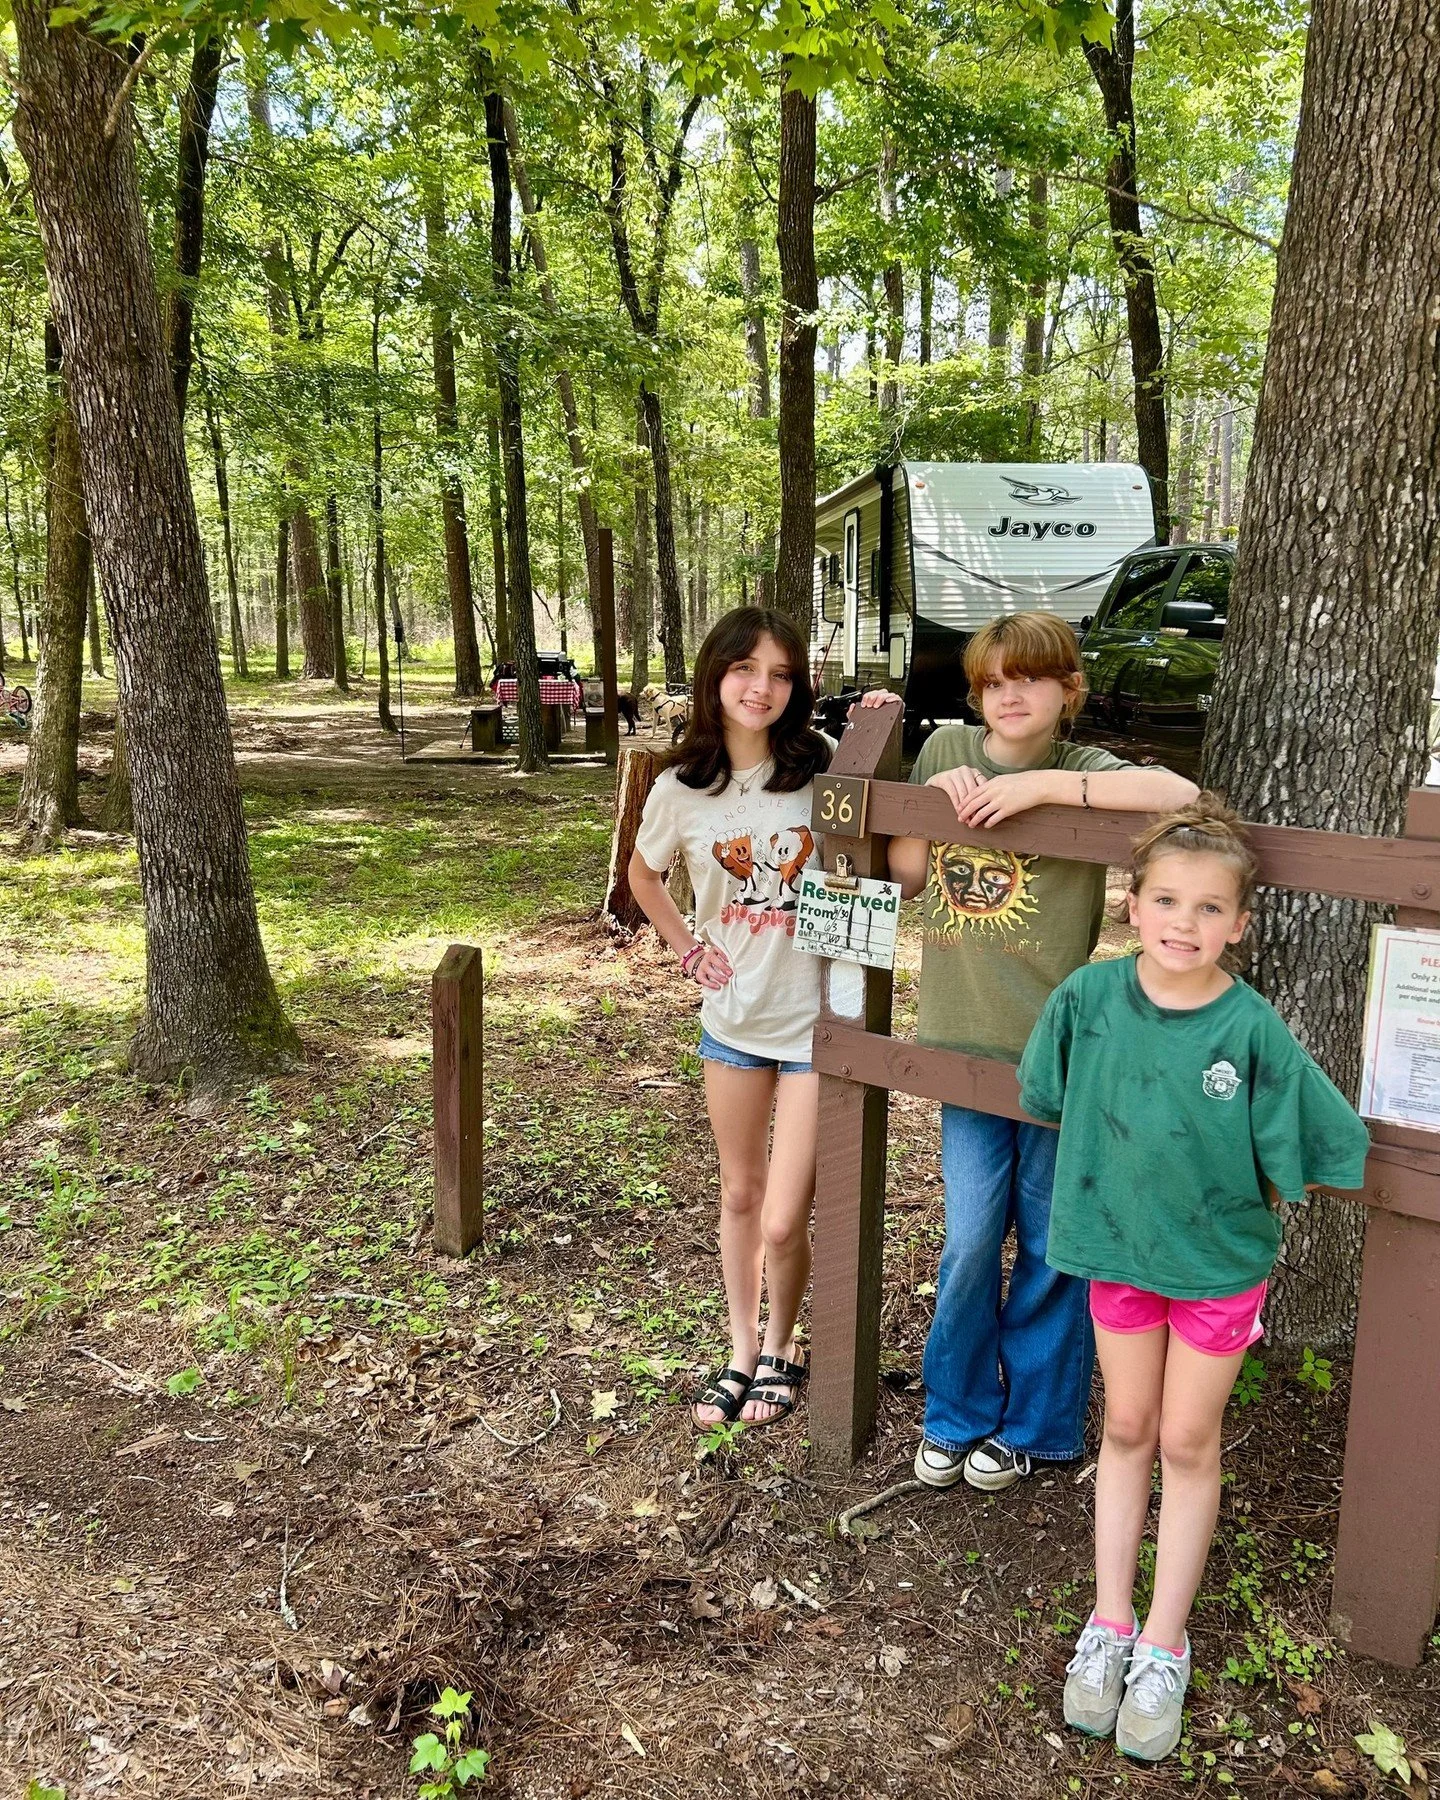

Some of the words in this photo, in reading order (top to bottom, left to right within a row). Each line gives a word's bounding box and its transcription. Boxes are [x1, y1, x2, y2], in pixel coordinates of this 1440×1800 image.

[988, 516, 1097, 541] Jayco
[724, 805, 747, 821] NO
[820, 790, 853, 823] 36
[802, 881, 897, 913] Reserved
[878, 883, 893, 896] 36
[800, 903, 834, 920] From
[799, 918, 815, 931] To
[1411, 972, 1430, 983] Only
